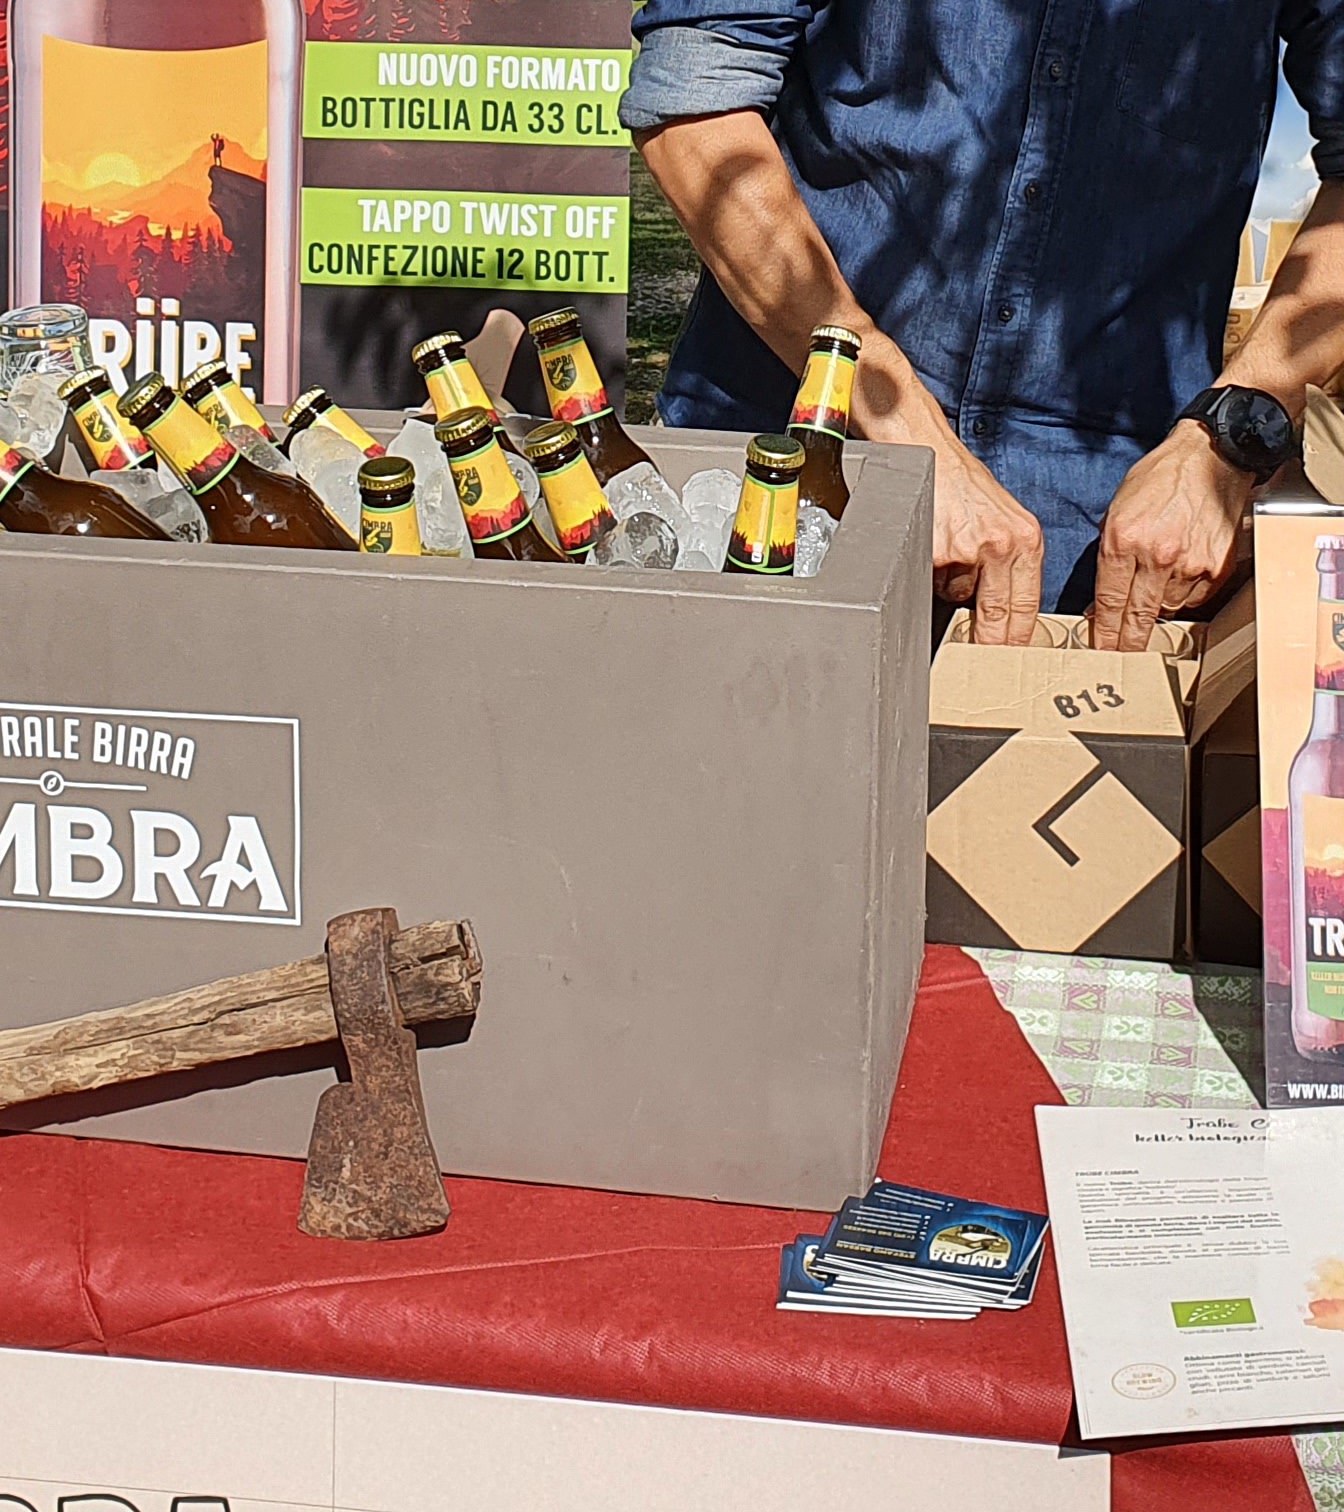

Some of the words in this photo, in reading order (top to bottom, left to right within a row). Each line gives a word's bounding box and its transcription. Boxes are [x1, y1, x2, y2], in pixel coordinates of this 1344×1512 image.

[377, 52, 478, 88] NUOVO
[486, 54, 621, 93] FORMATO
[321, 96, 473, 132] BOTTIGLIA
[481, 98, 518, 133] DA
[527, 100, 565, 135] 33
[575, 101, 619, 136] CL.
[358, 199, 453, 236] TAPPO
[459, 201, 555, 238] TWIST
[565, 204, 618, 240] OFF
[307, 243, 486, 280] CONFEZIONE
[494, 247, 524, 281] 12
[534, 248, 616, 285] BOTT.
[87, 297, 257, 404] RÜBE
[93, 720, 196, 781] BIRRA
[929, 1249, 1007, 1269] CIMBRA
